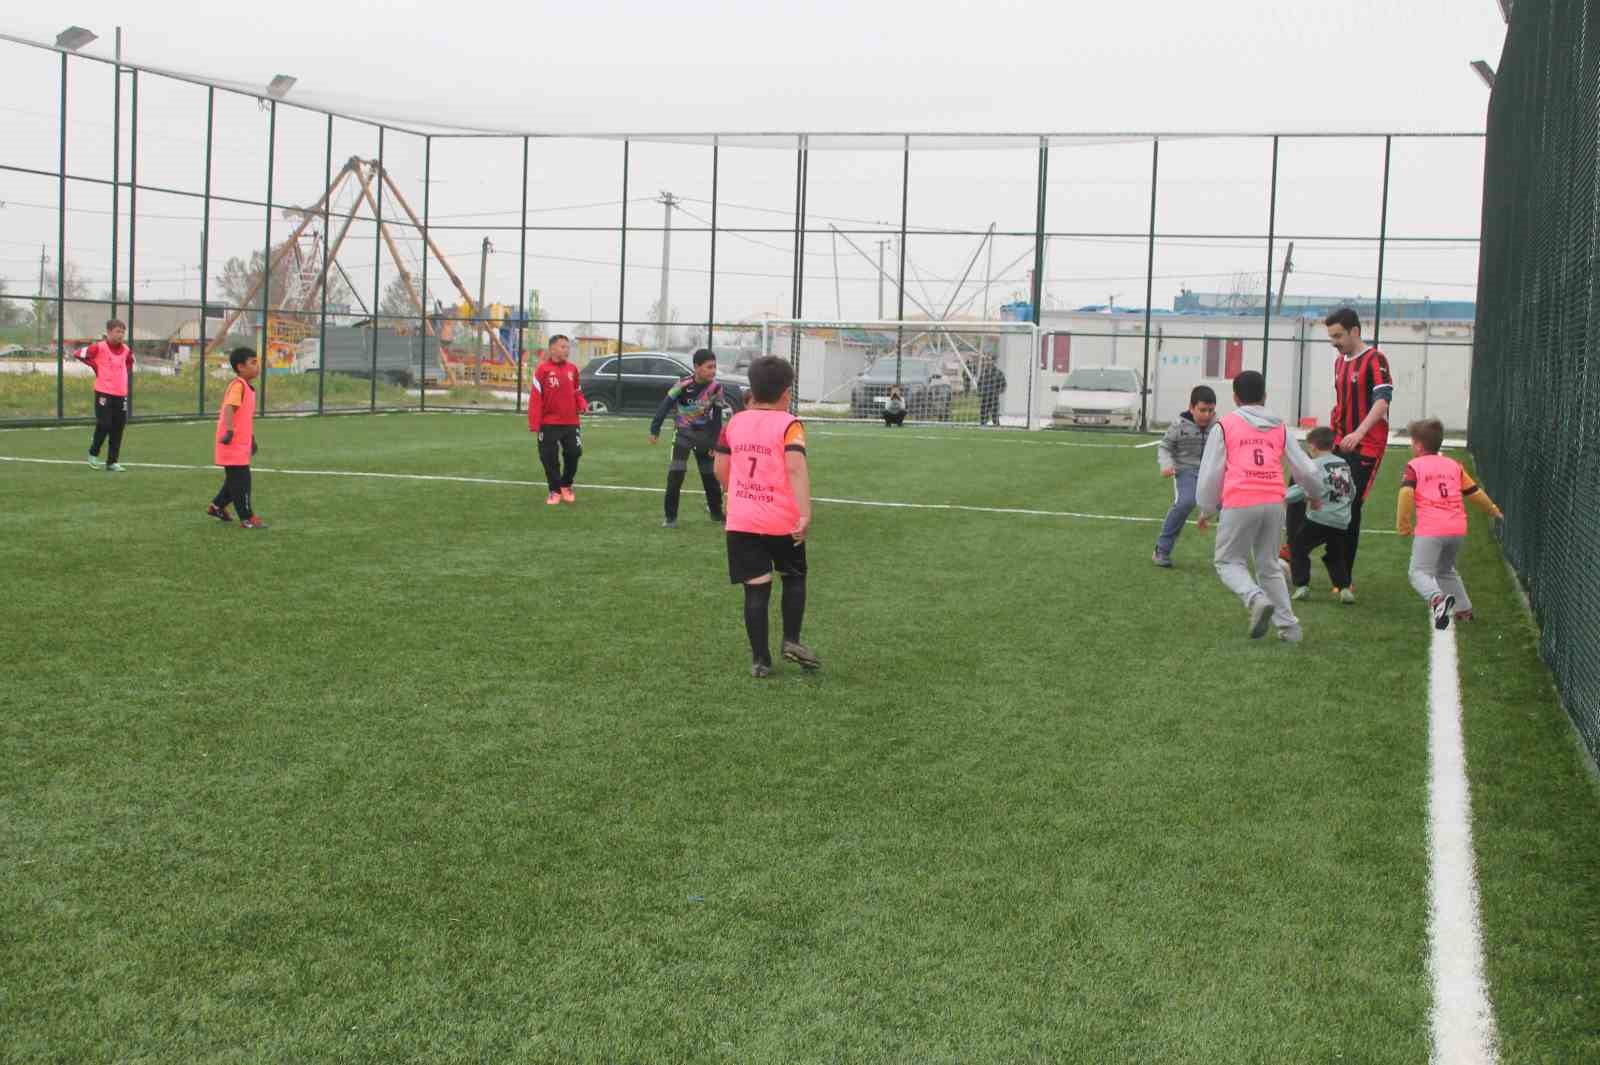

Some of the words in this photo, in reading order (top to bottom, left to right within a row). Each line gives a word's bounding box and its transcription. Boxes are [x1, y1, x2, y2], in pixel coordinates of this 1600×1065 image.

[1253, 448, 1265, 466] 6
[748, 457, 758, 478] 7
[1438, 481, 1448, 498] 6
